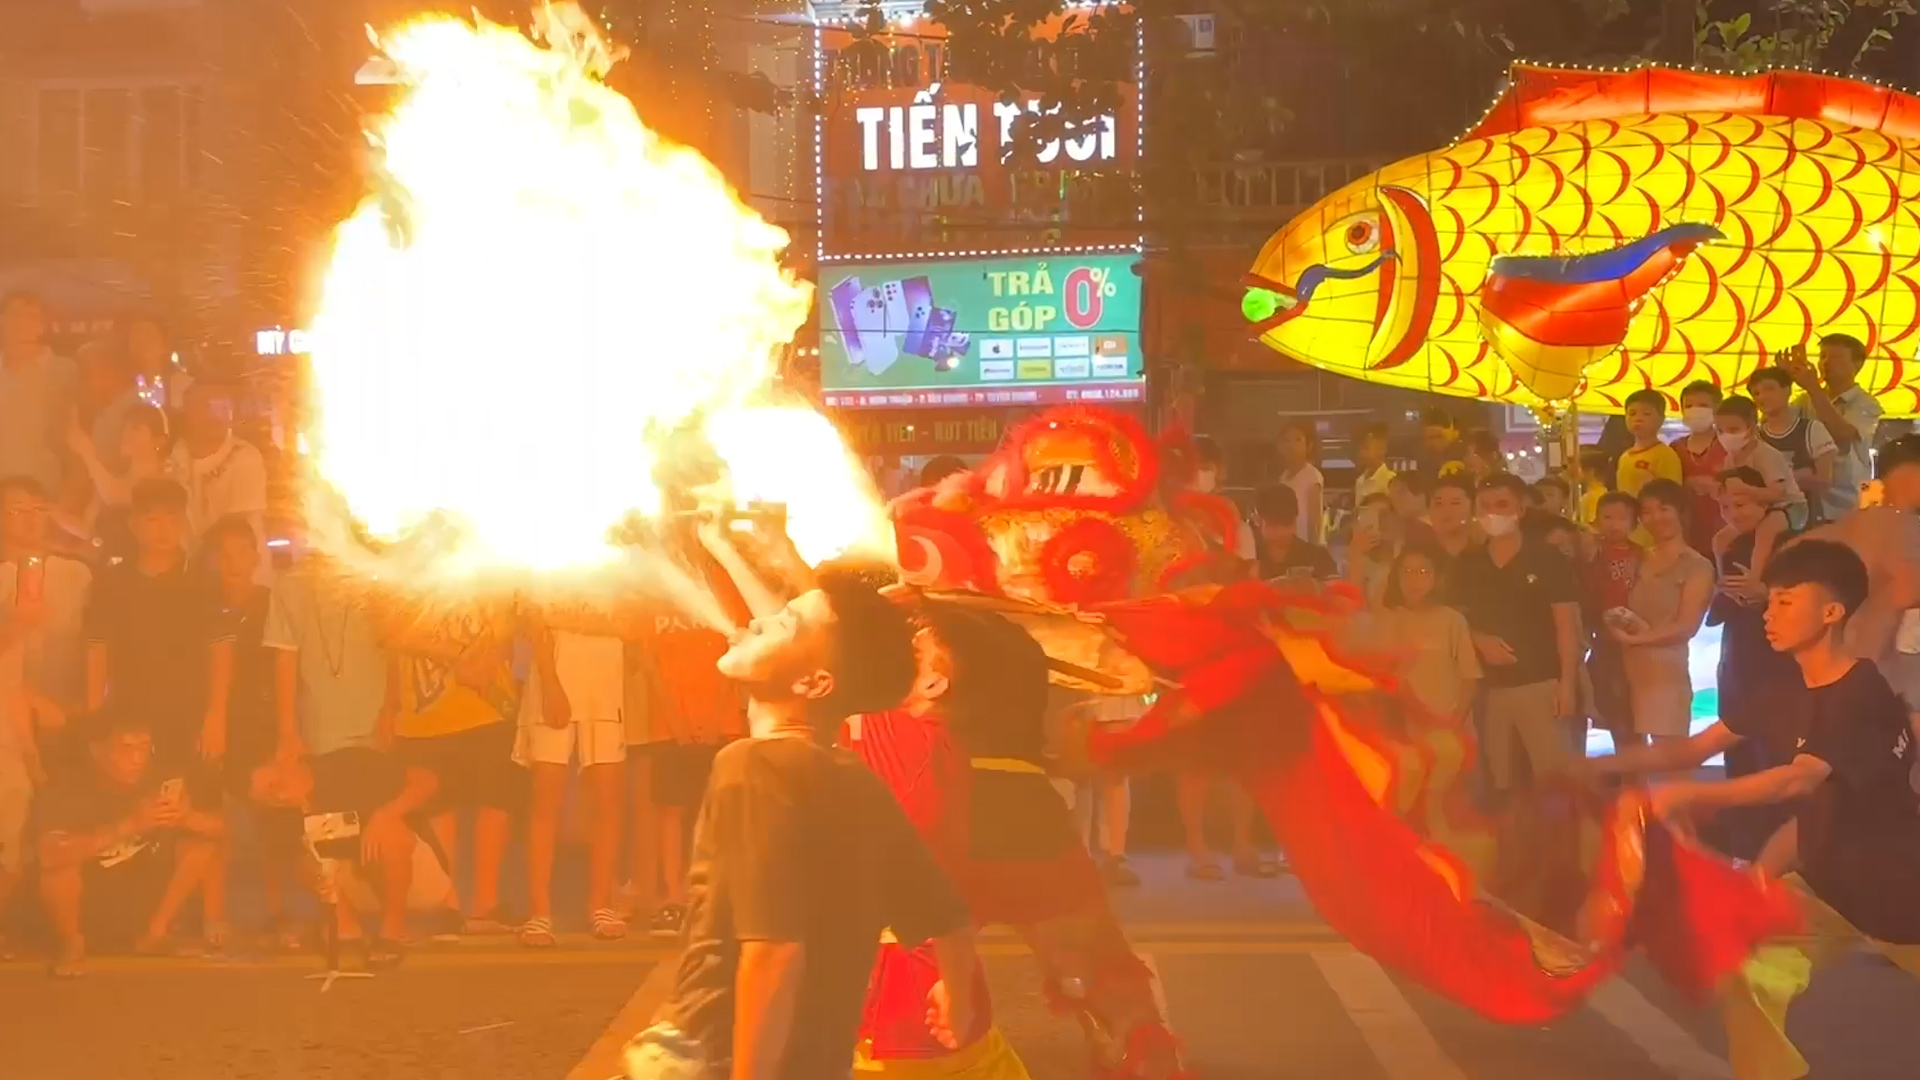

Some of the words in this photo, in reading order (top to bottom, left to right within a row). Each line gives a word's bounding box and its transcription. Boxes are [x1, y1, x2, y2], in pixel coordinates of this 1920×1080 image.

[857, 82, 977, 170] TIẾN
[987, 262, 1054, 297] TRẢ
[1063, 266, 1117, 330] 0%
[988, 301, 1056, 331] GÓP
